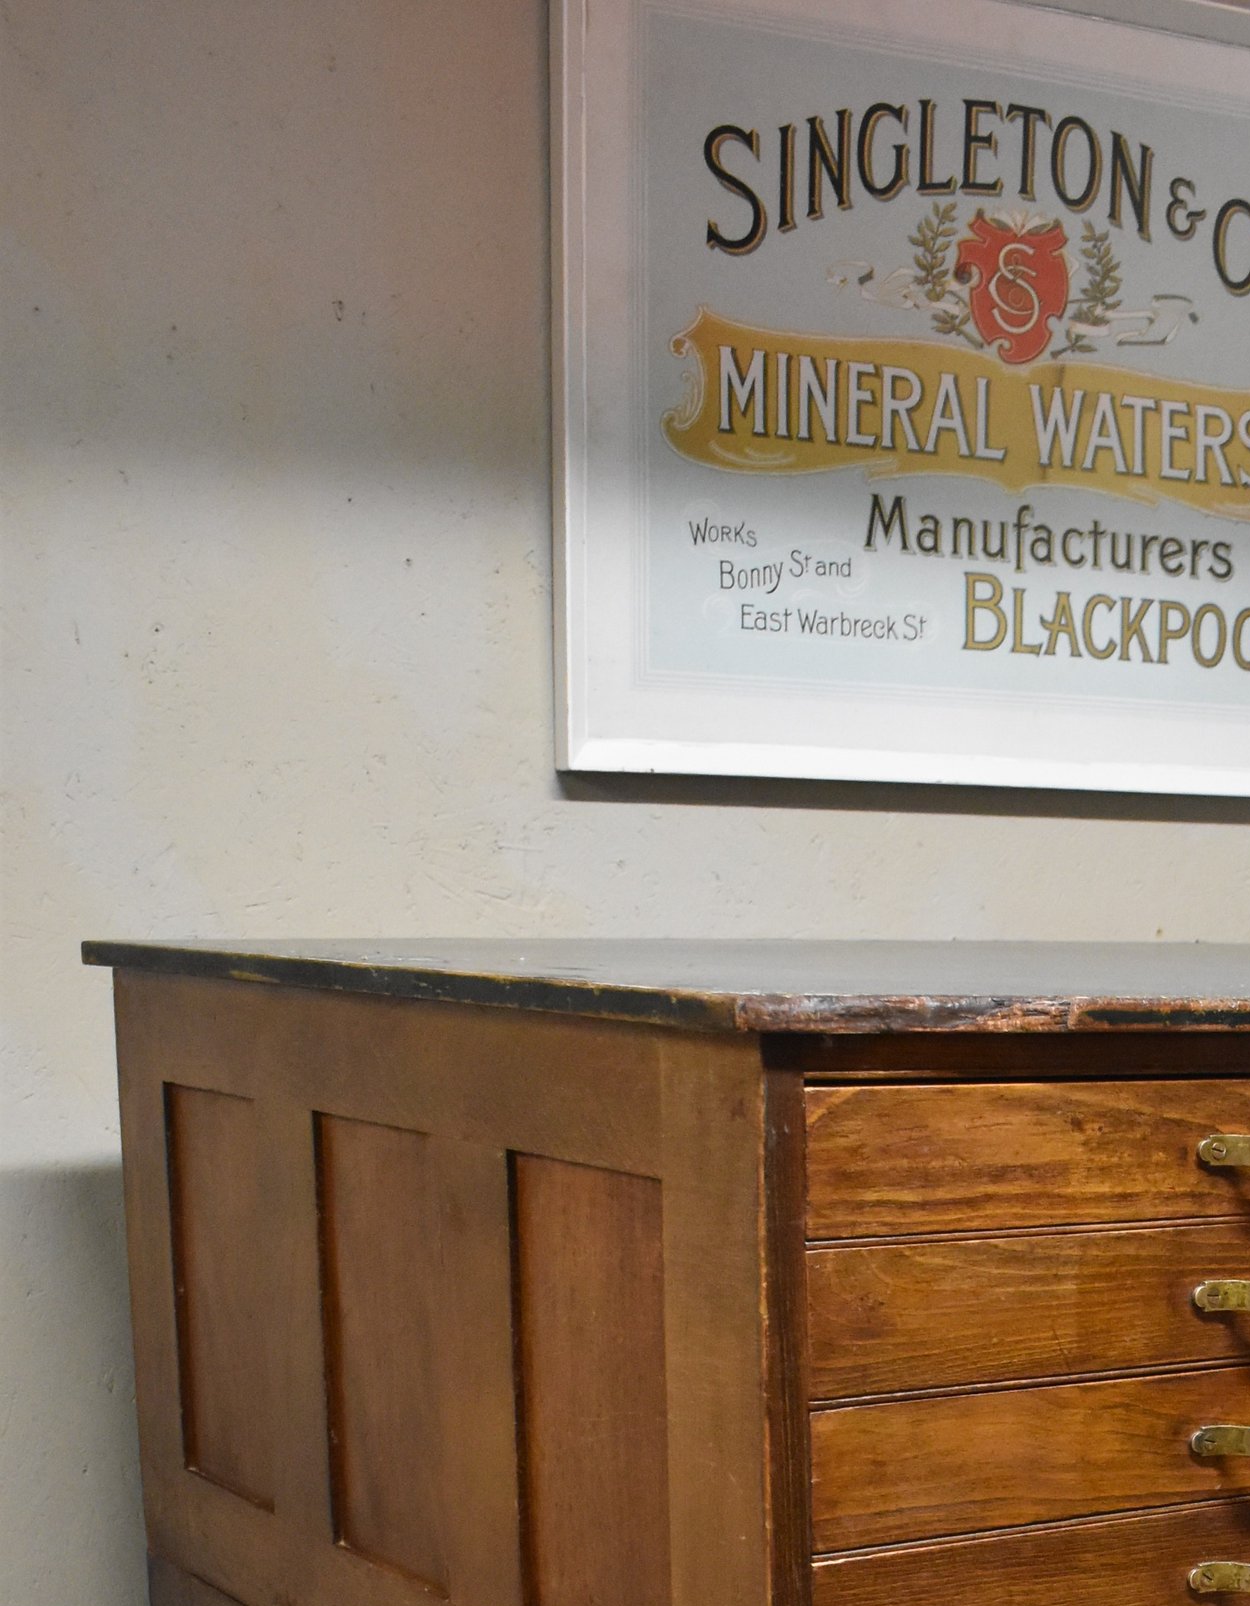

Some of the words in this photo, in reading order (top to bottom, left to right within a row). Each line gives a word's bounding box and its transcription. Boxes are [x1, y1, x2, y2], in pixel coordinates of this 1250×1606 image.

[703, 98, 1155, 258] SINGLETON
[716, 344, 1007, 464] MINERAL
[719, 560, 784, 594] Bonny
[815, 557, 852, 578] and
[864, 493, 1235, 583] Manufacturers
[740, 603, 793, 632] East
[797, 608, 900, 641] Warbreck
